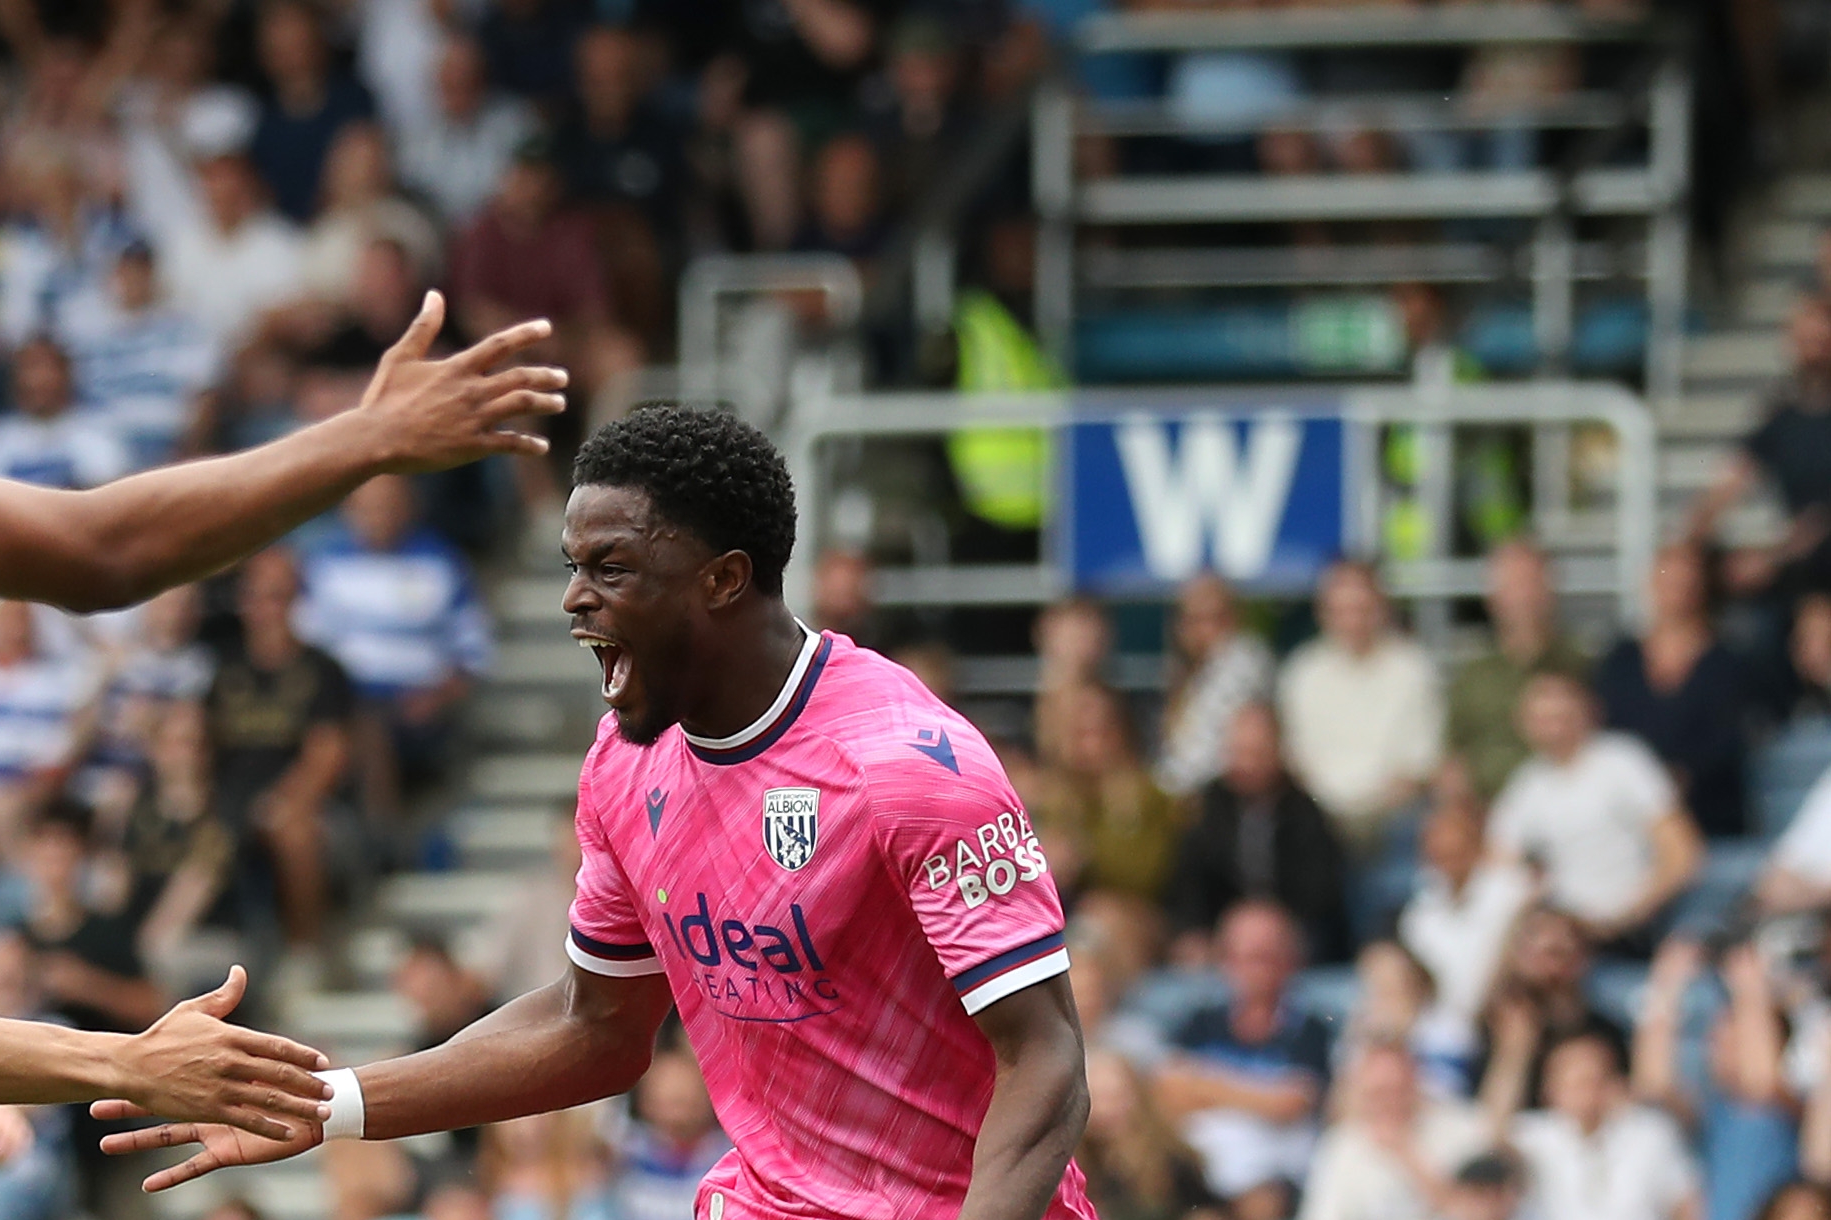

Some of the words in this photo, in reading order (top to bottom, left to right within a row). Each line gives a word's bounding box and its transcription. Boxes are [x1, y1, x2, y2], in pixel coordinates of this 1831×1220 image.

[1113, 408, 1306, 580] W
[767, 800, 814, 814] ALBION
[957, 837, 1048, 909] BOSS
